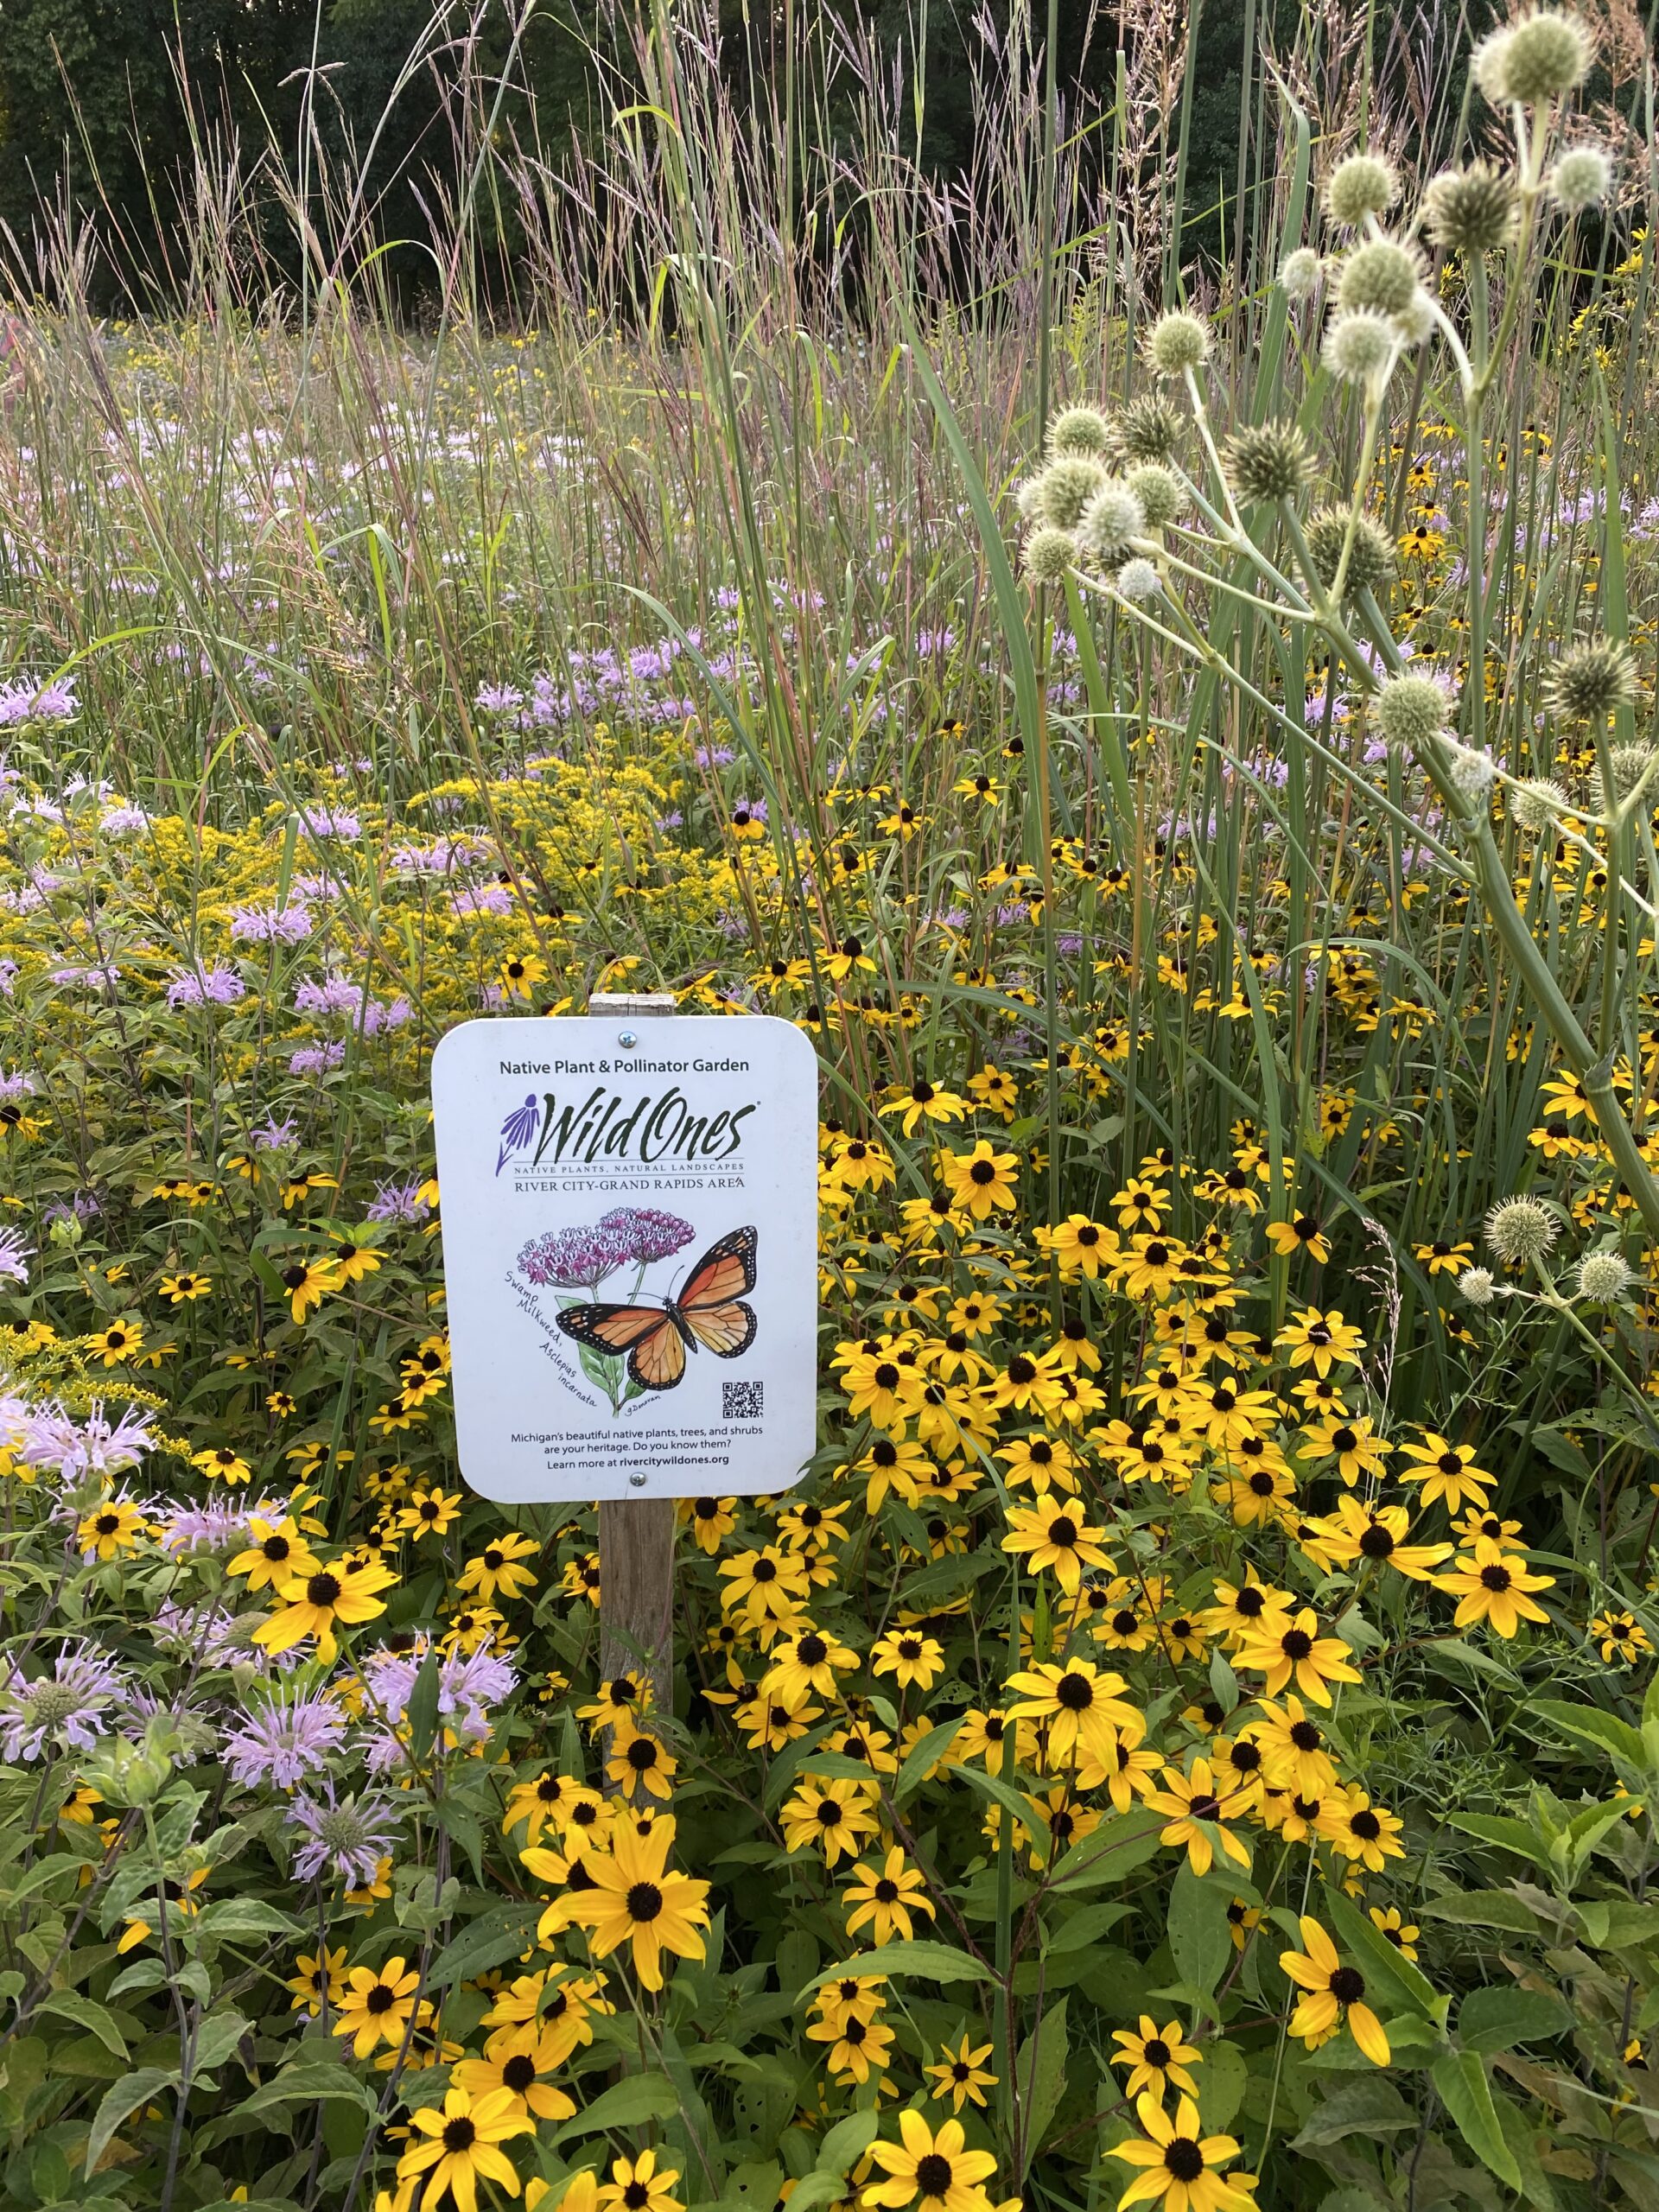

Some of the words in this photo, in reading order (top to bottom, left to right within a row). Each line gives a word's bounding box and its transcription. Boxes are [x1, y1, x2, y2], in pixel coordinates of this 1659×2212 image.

[499, 1060, 550, 1074] Native
[555, 1060, 595, 1074] Plant
[599, 1059, 611, 1073] &
[614, 1058, 689, 1073] Pollinator
[693, 1058, 749, 1072] Garden
[533, 1087, 651, 1166] Wild
[639, 1086, 756, 1163] Ones
[515, 1182, 558, 1192] RIVER
[563, 1180, 649, 1191] CITY-GRAND
[654, 1179, 703, 1189] RAPIDS
[708, 1177, 746, 1188] AREA
[505, 1271, 538, 1306] Swamp
[539, 1342, 576, 1377] Asclepias
[558, 1373, 597, 1407] incarnata
[512, 1432, 564, 1444] Michigan's
[566, 1430, 611, 1441] beautiful
[613, 1428, 643, 1439] native
[645, 1427, 678, 1439] plants,
[680, 1427, 707, 1437] trees,
[709, 1426, 728, 1436] and
[730, 1425, 763, 1435] shrubs
[562, 1446, 586, 1456] your
[588, 1442, 631, 1453] heritage.
[633, 1442, 647, 1451] Do
[650, 1443, 669, 1452] you
[671, 1440, 698, 1450] know
[701, 1440, 732, 1449] them?
[547, 1459, 576, 1470] Learn
[578, 1460, 604, 1469] more
[620, 1455, 729, 1468] rivercitywildones.org
